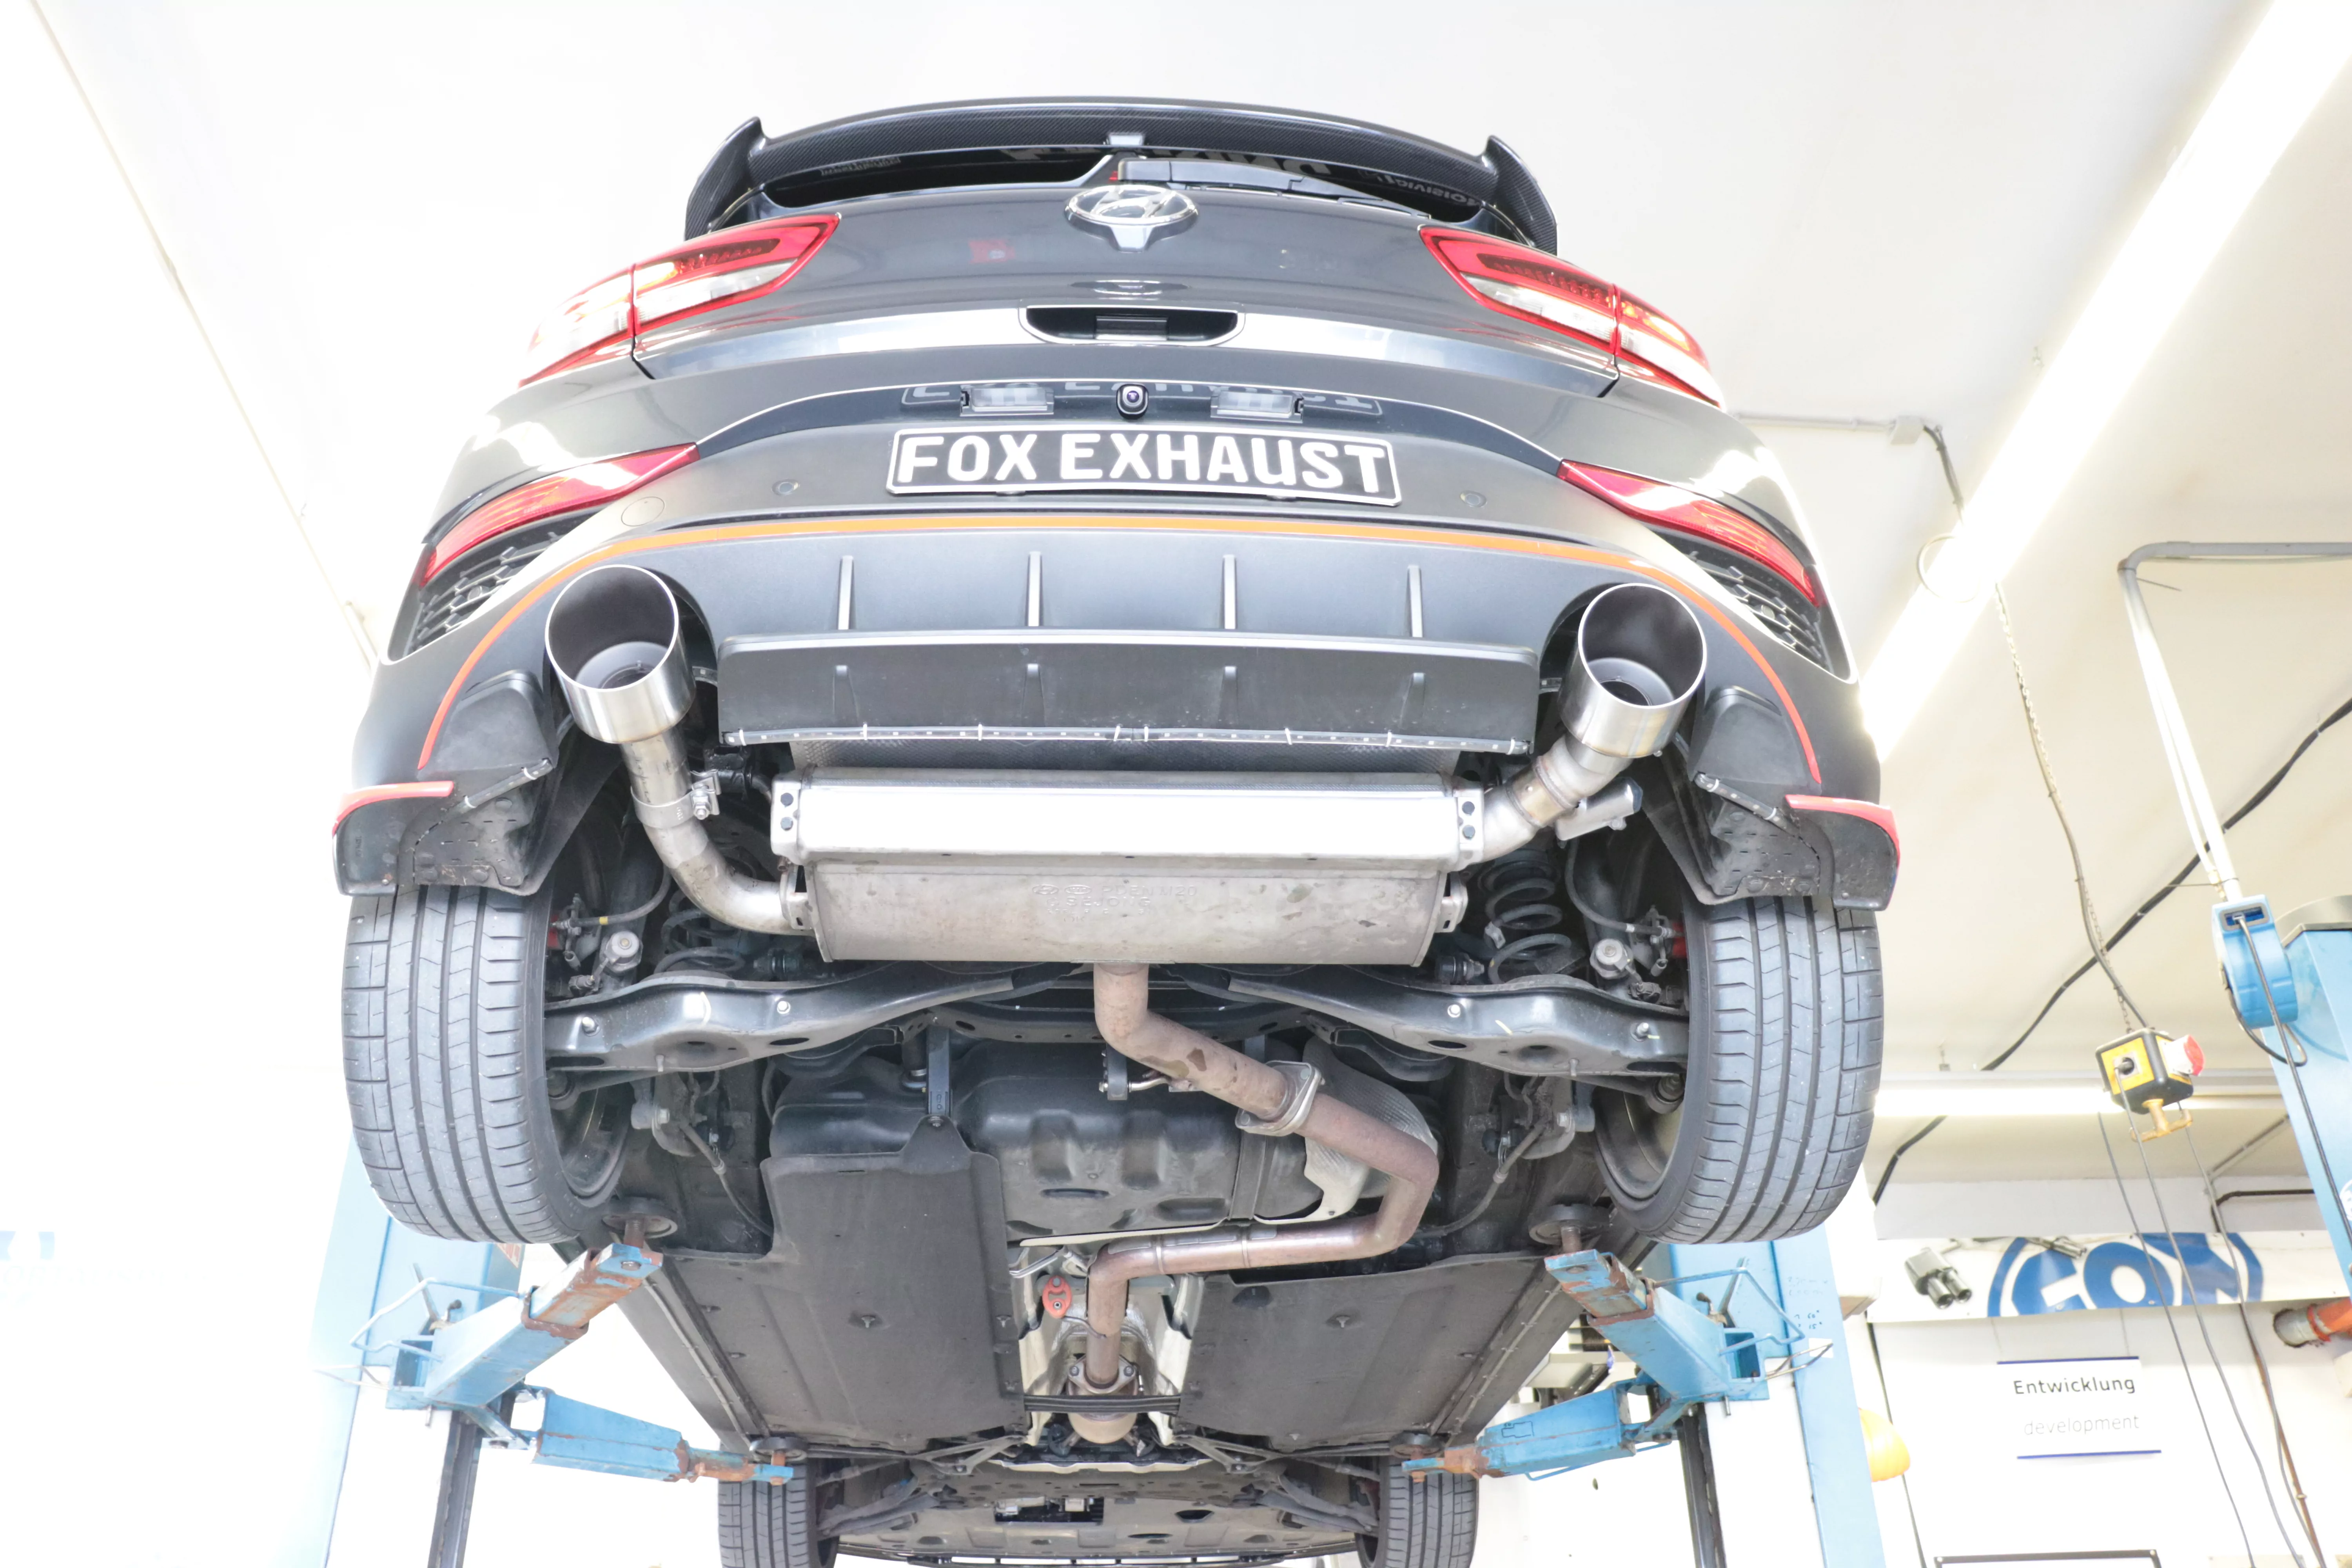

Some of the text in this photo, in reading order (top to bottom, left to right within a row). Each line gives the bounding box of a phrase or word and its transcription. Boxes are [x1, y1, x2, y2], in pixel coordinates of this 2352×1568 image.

[897, 433, 1385, 493] FOX EXHAUST
[2013, 1376, 2136, 1394] Entwicklung
[2024, 1415, 2140, 1435] development
